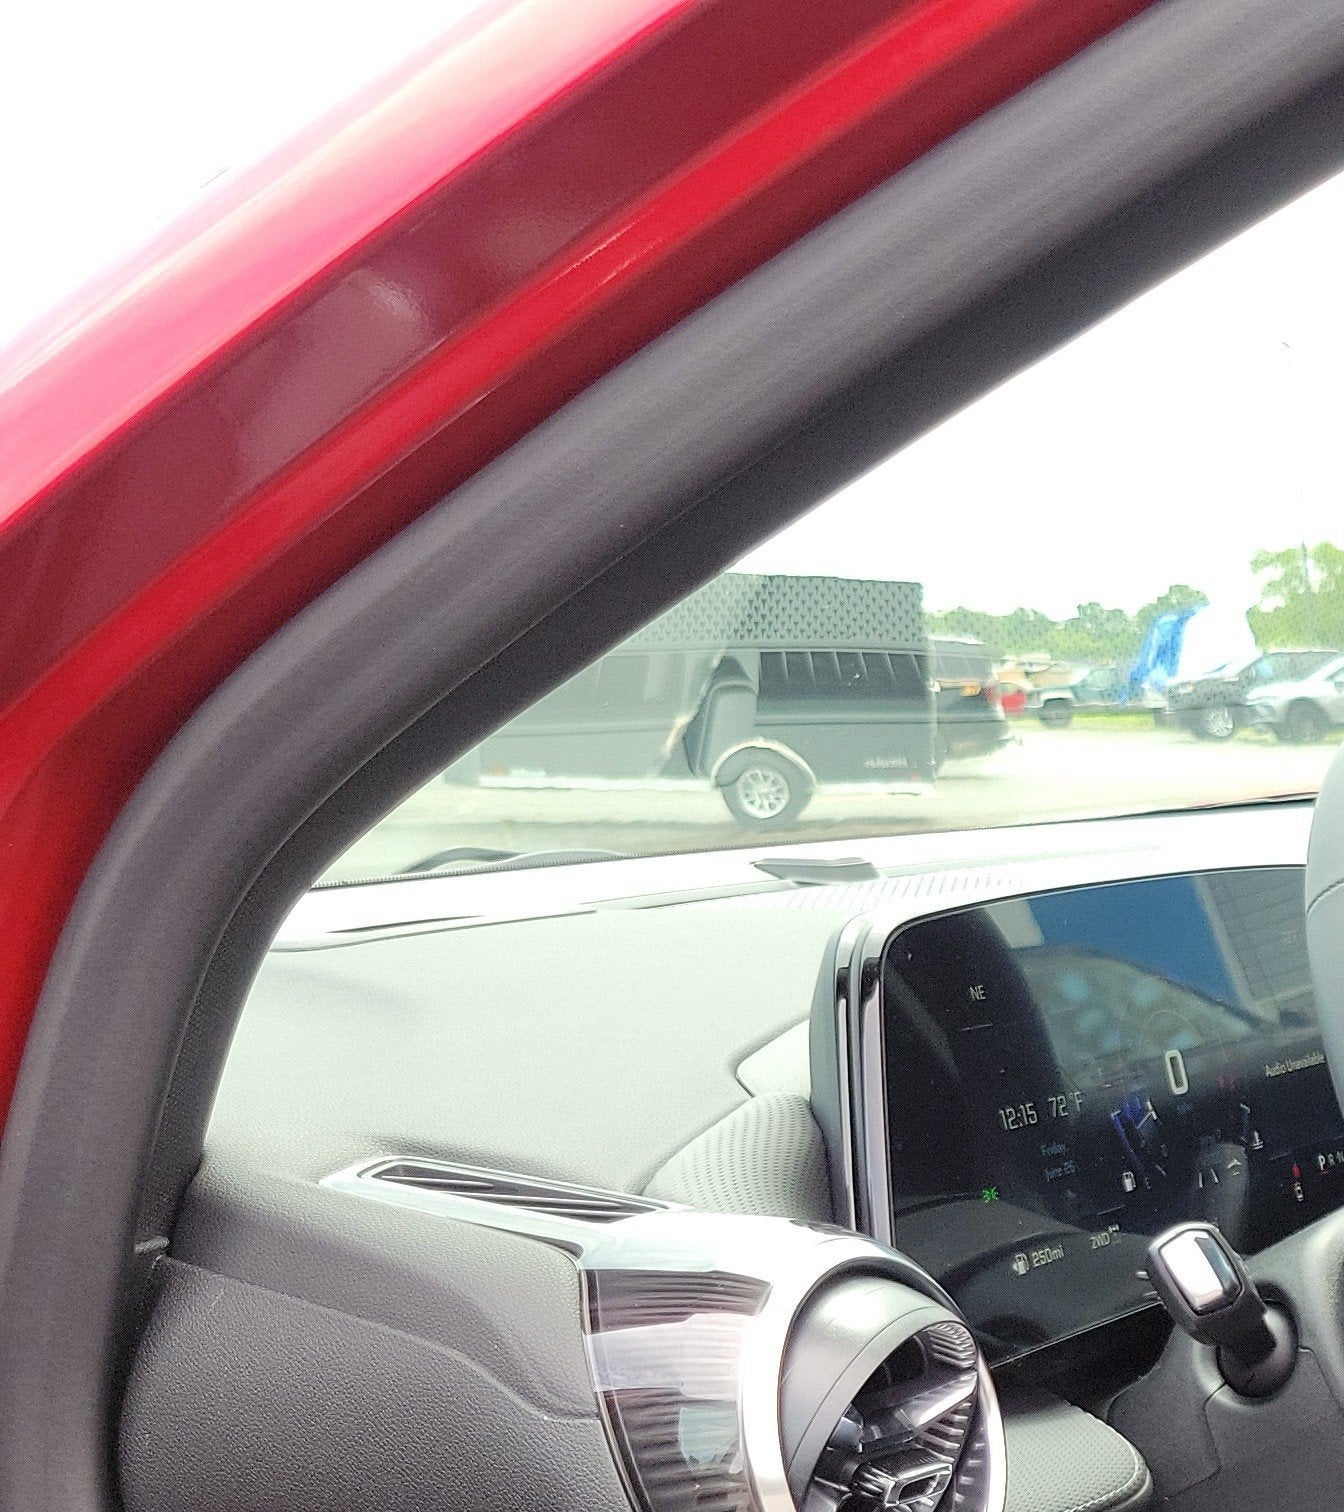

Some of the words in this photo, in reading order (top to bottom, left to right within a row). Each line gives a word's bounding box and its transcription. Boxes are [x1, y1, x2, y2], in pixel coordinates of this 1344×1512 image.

[969, 985, 987, 1001] NE
[1165, 1049, 1189, 1095] 0
[999, 1103, 1038, 1130] 12:15
